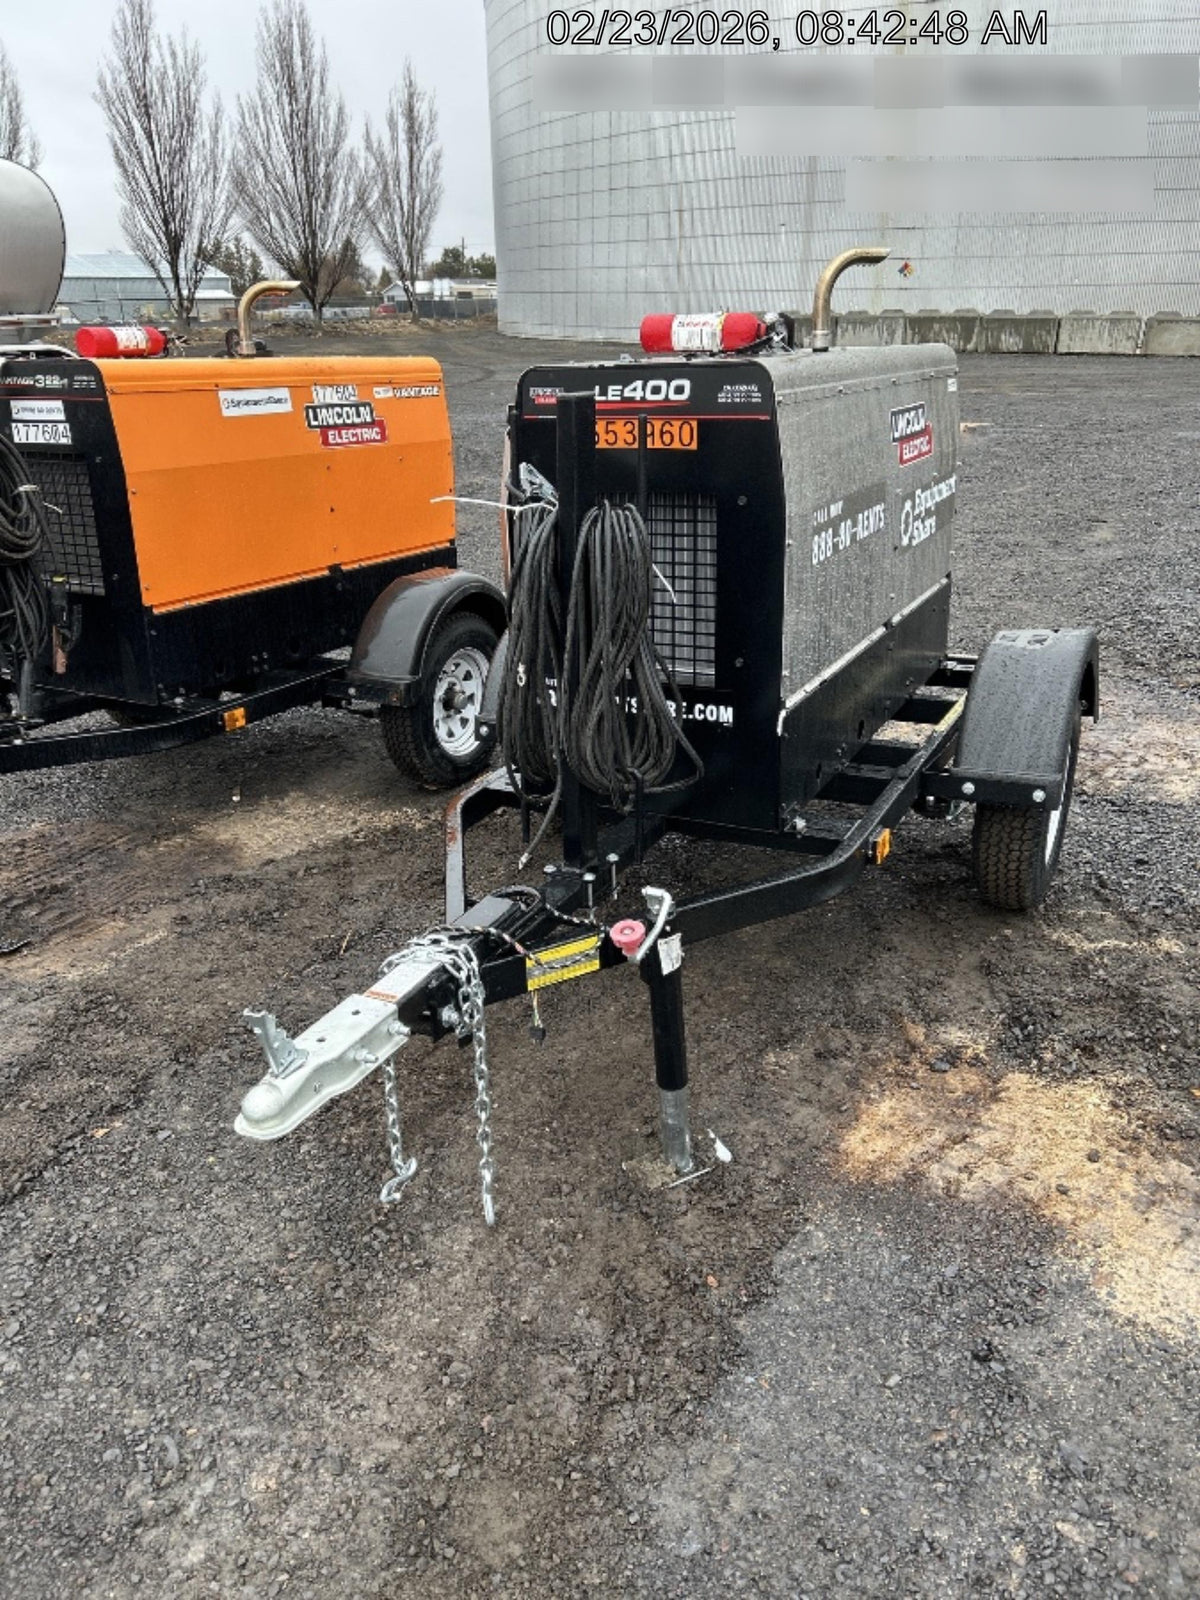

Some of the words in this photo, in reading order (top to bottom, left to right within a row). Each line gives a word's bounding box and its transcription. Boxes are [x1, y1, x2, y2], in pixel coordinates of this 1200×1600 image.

[393, 386, 440, 398] VANTAGE
[308, 405, 372, 426] LINCOLN
[892, 408, 926, 438] LINCOLN
[328, 427, 381, 443] ELECTRIC
[902, 435, 931, 460] ELECTRIC
